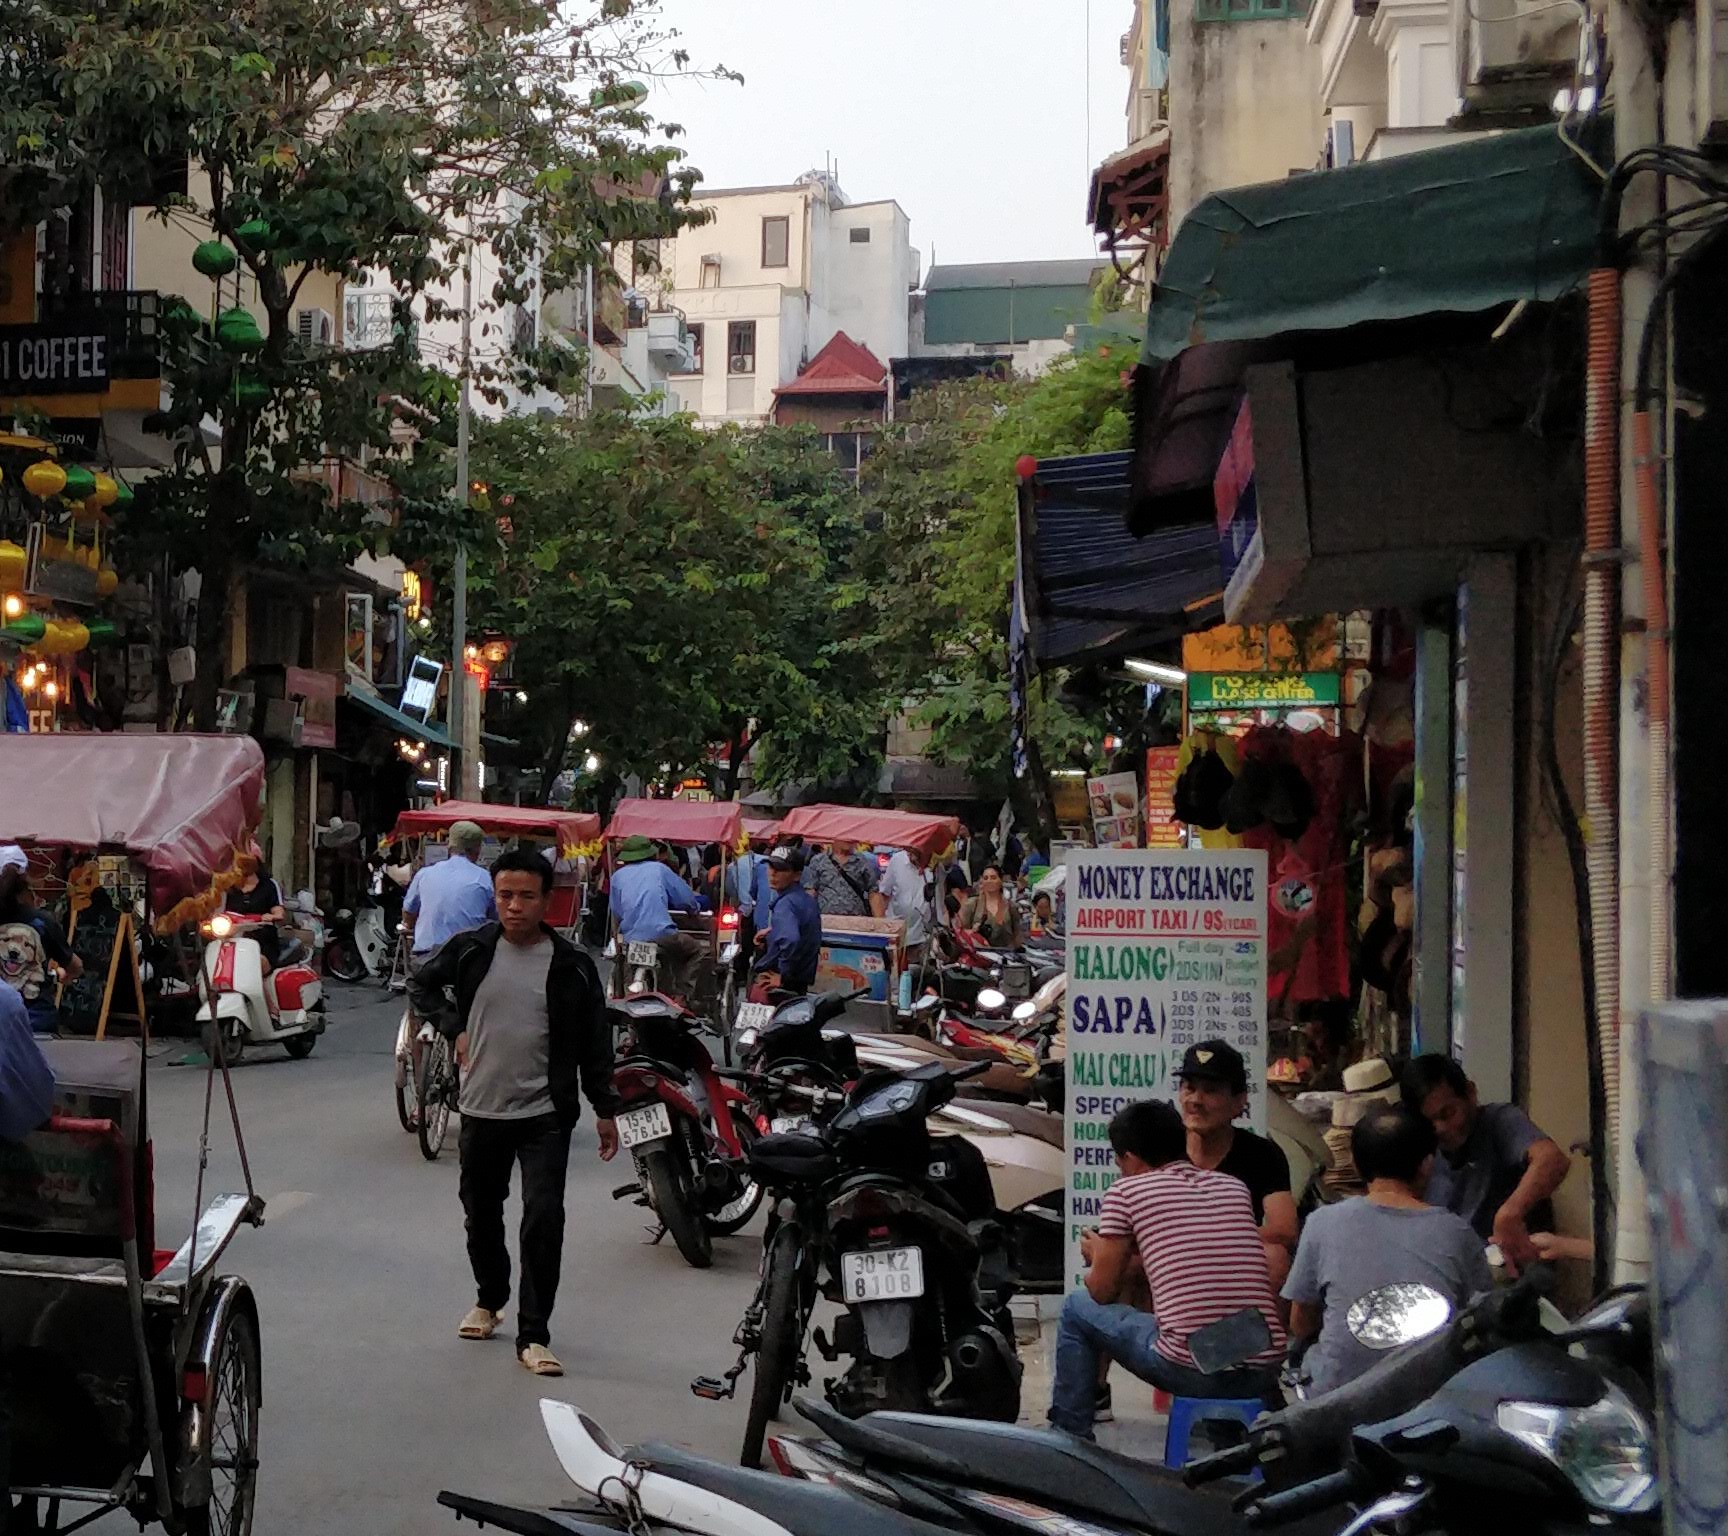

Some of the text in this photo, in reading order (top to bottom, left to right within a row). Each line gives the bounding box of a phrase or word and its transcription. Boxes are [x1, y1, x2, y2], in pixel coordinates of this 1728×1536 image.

[19, 336, 106, 380] COFFEE
[1078, 865, 1254, 902] MONEY EXCHANGE
[1077, 908, 1145, 929] AIRPORT
[1152, 909, 1187, 929] TAXI
[1074, 945, 1167, 981] HALONG
[1073, 995, 1156, 1034] SAPA
[1073, 1052, 1104, 1087] MAI
[1108, 1052, 1156, 1088] CHAU
[1076, 1096, 1128, 1115] SPEC
[1075, 1147, 1116, 1165] PERF
[1074, 1172, 1099, 1190] BAI
[1073, 1198, 1104, 1215] HAN
[855, 1251, 909, 1275] 30-K2
[855, 1274, 910, 1298] 8108
